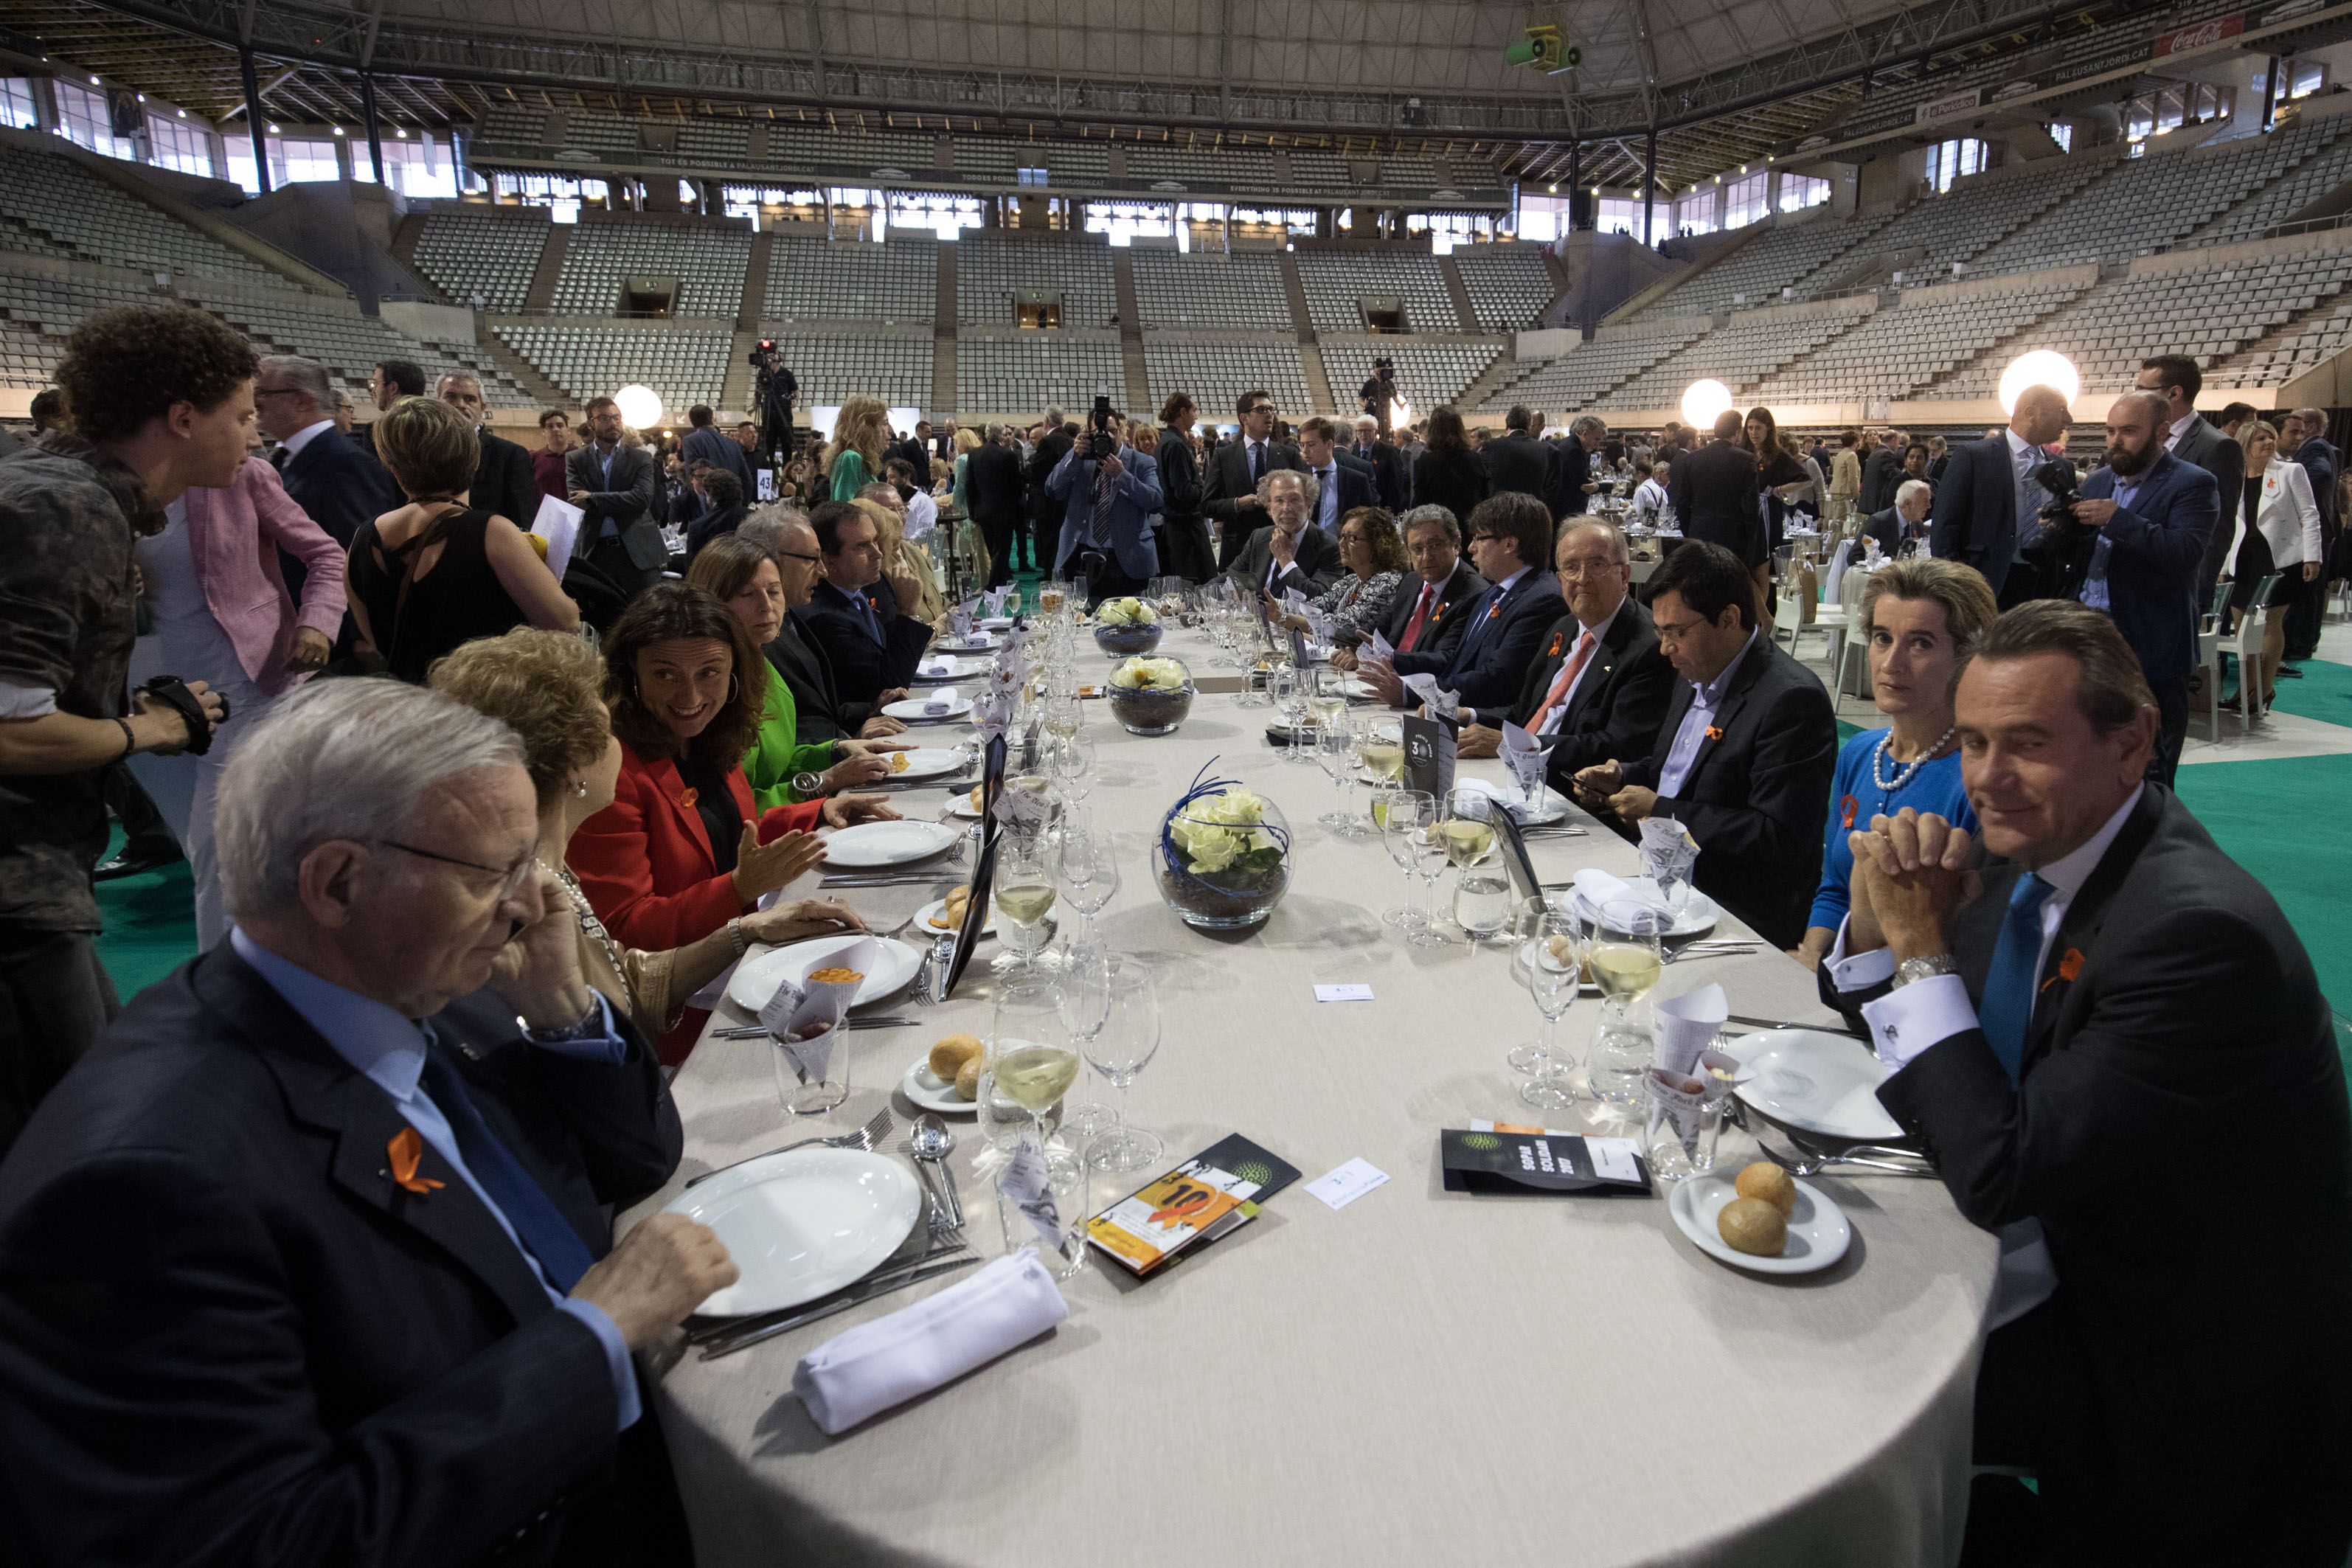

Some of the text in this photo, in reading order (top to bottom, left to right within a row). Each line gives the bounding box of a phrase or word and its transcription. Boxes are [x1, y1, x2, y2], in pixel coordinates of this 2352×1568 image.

[2056, 46, 2149, 82] PALAUSANTJORDI.CAT
[1844, 114, 1912, 137] PALAUSANTJORDI.CAT
[690, 159, 728, 169] POSSIBLE
[738, 163, 814, 173] PALAUSANTJORDI.CAT
[1323, 189, 1390, 197] PALAUSANTJORDI.CAT
[760, 476, 771, 490] 43
[1519, 1145, 1536, 1171] SOPAR
[1535, 1139, 1555, 1173] SOLIDARI
